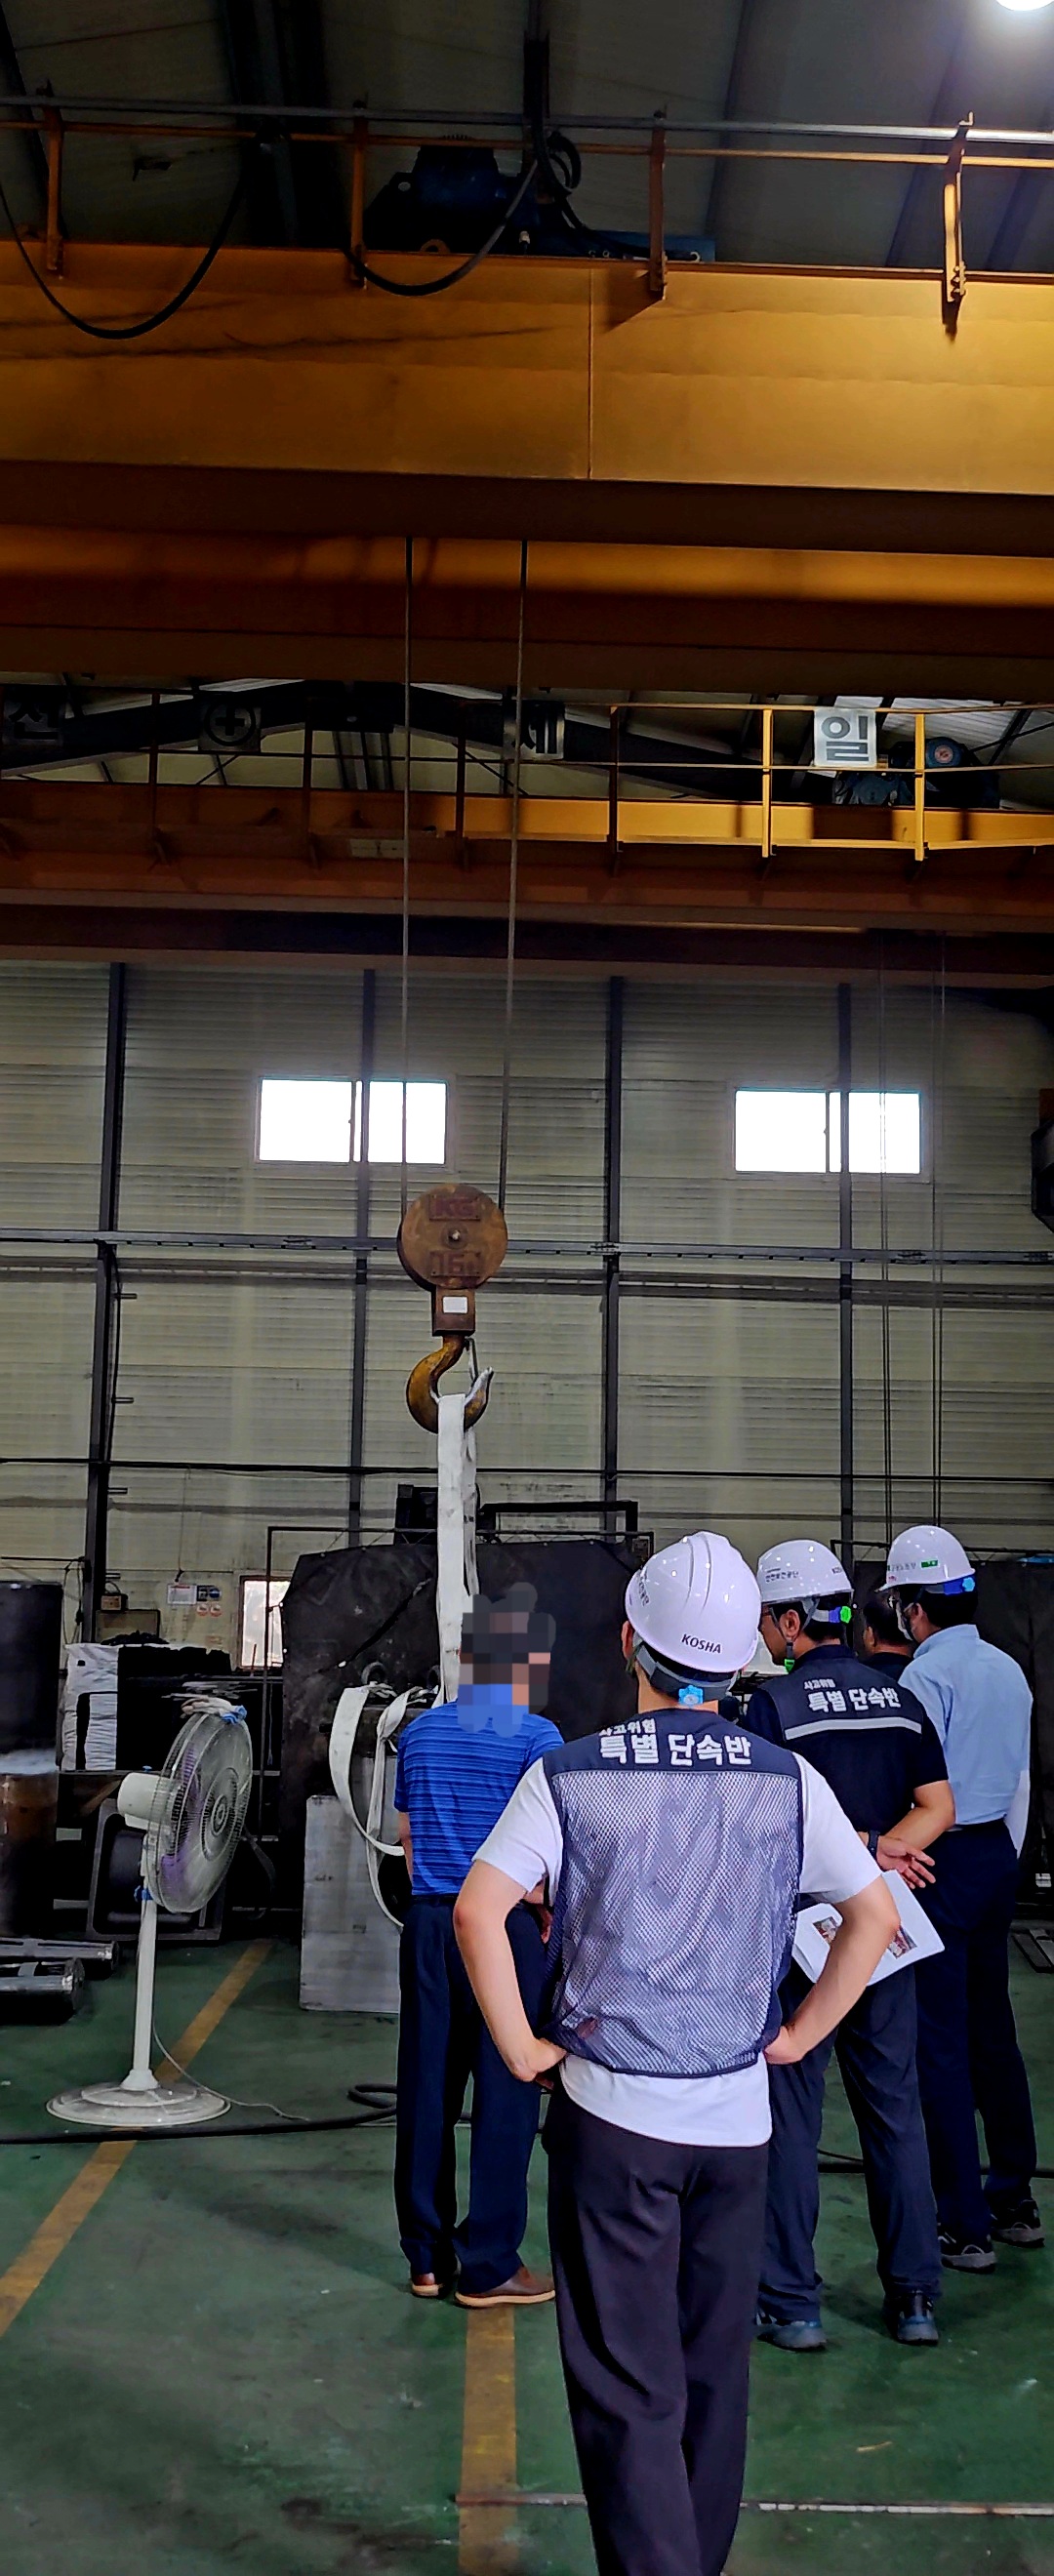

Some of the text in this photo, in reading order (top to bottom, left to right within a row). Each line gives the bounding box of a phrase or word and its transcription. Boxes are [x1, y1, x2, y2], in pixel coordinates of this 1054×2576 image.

[821, 715, 870, 762] 일
[681, 1633, 722, 1654] KOSHA
[808, 1687, 901, 1712] 특별 단속반
[600, 1733, 752, 1766] 특별 단속반
